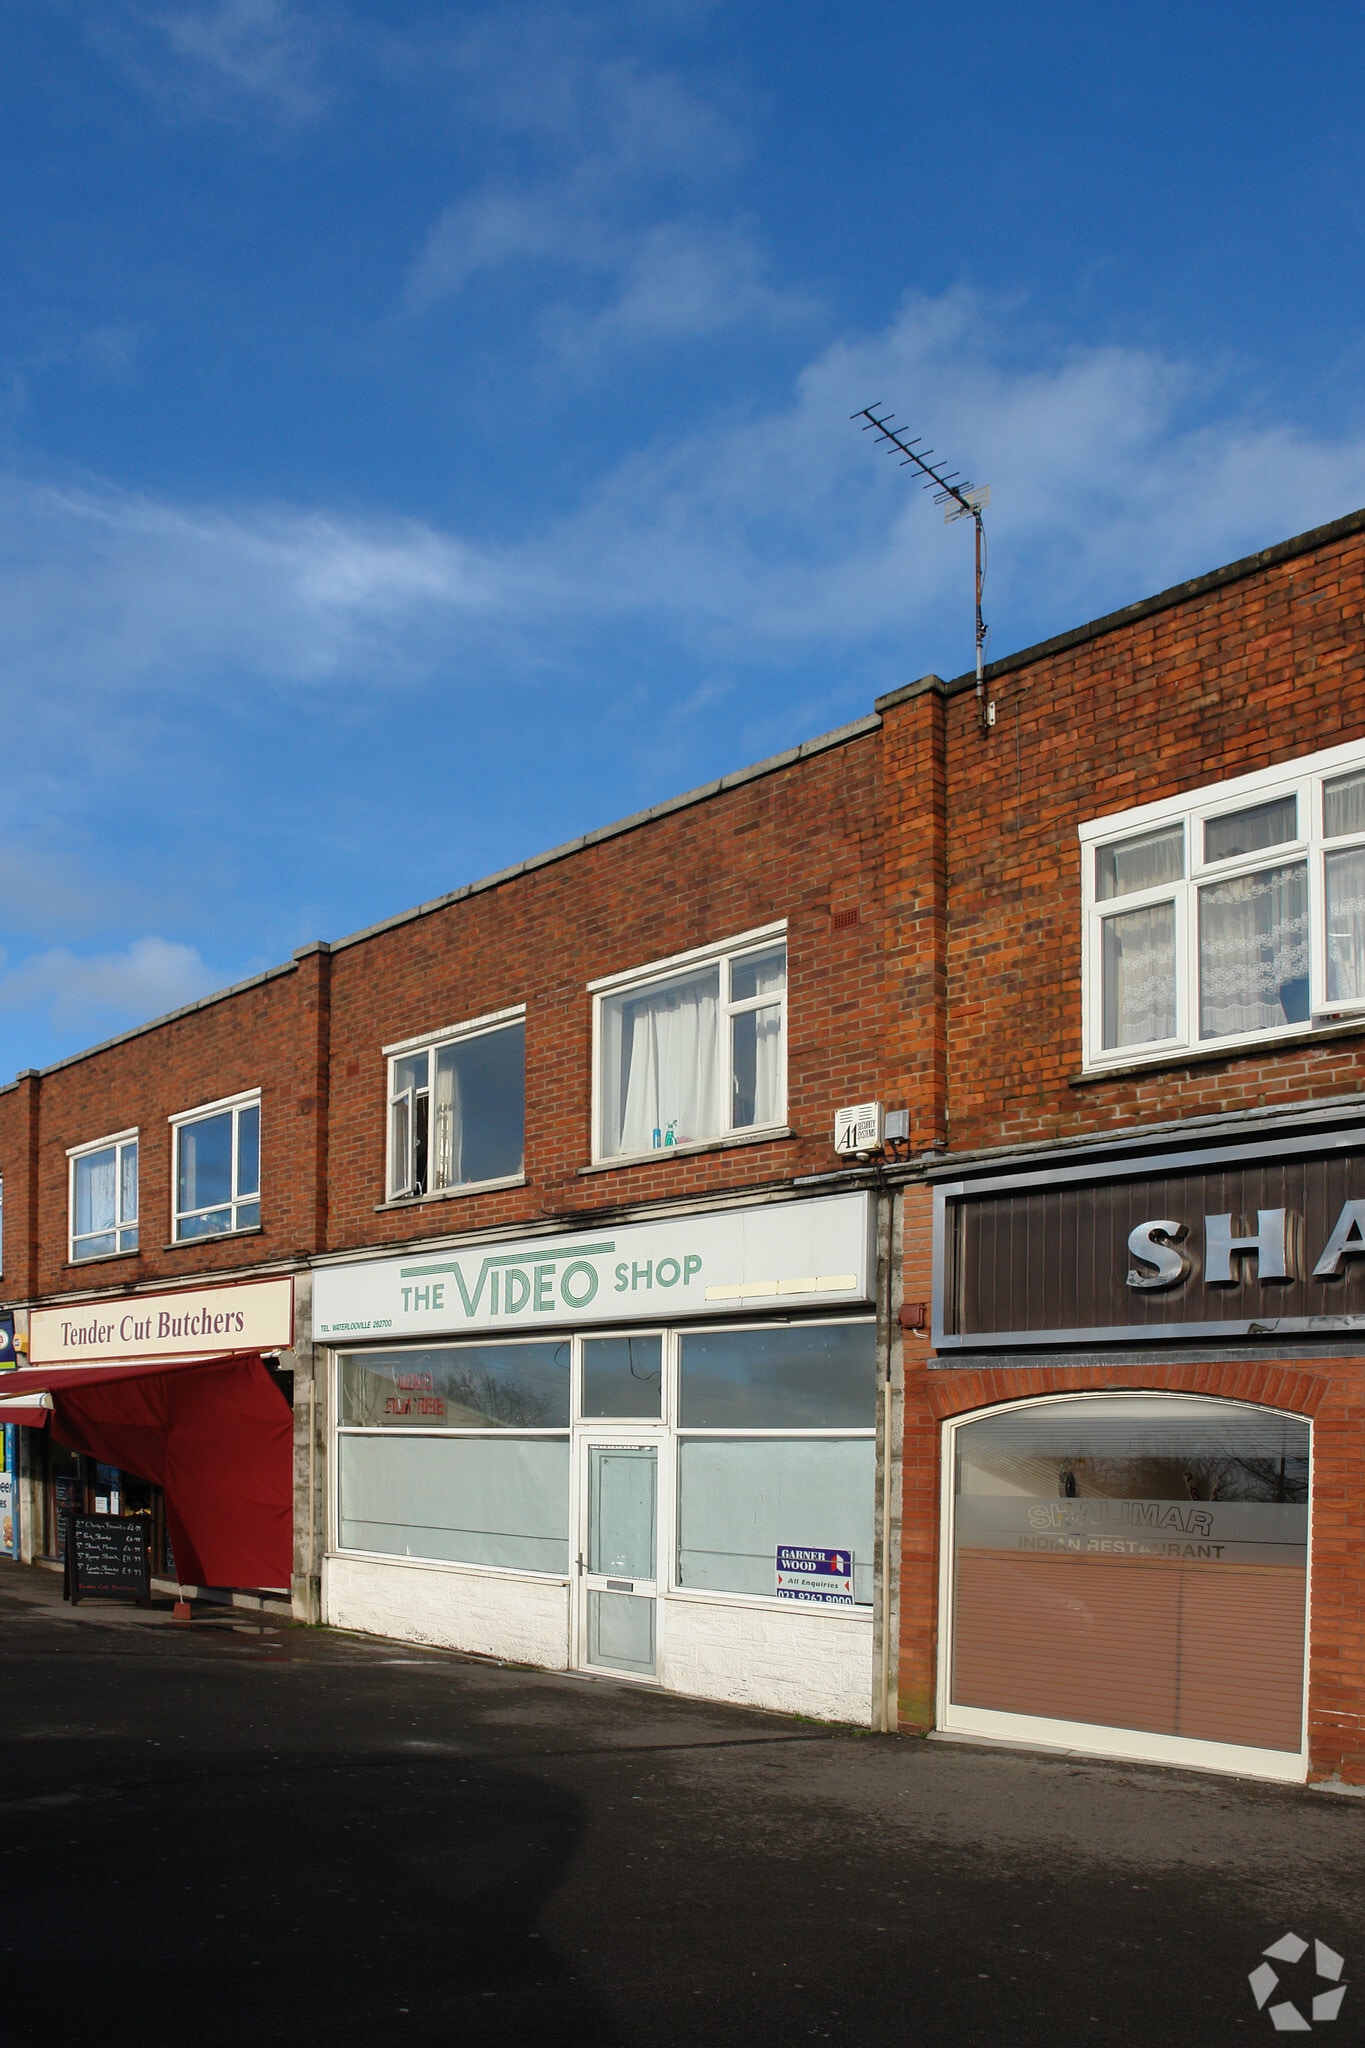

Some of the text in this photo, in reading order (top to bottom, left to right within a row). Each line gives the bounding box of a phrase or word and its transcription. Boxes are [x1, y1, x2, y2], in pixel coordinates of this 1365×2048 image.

[857, 1120, 876, 1131] SECURITY
[836, 1123, 858, 1149] A1
[857, 1128, 876, 1140] SYSTEMS
[400, 1241, 703, 1318] THE VIDEO SHOP
[61, 1307, 244, 1346] Tender Cut Butchers
[332, 1321, 371, 1331] WATERLOOVILLE
[1027, 1502, 1215, 1536] SHALIMAR
[1018, 1535, 1225, 1559] INDIAN RESTAURANT
[781, 1549, 826, 1561] GARNER
[781, 1559, 816, 1571] WOOD
[801, 1579, 839, 1588] Enquiries
